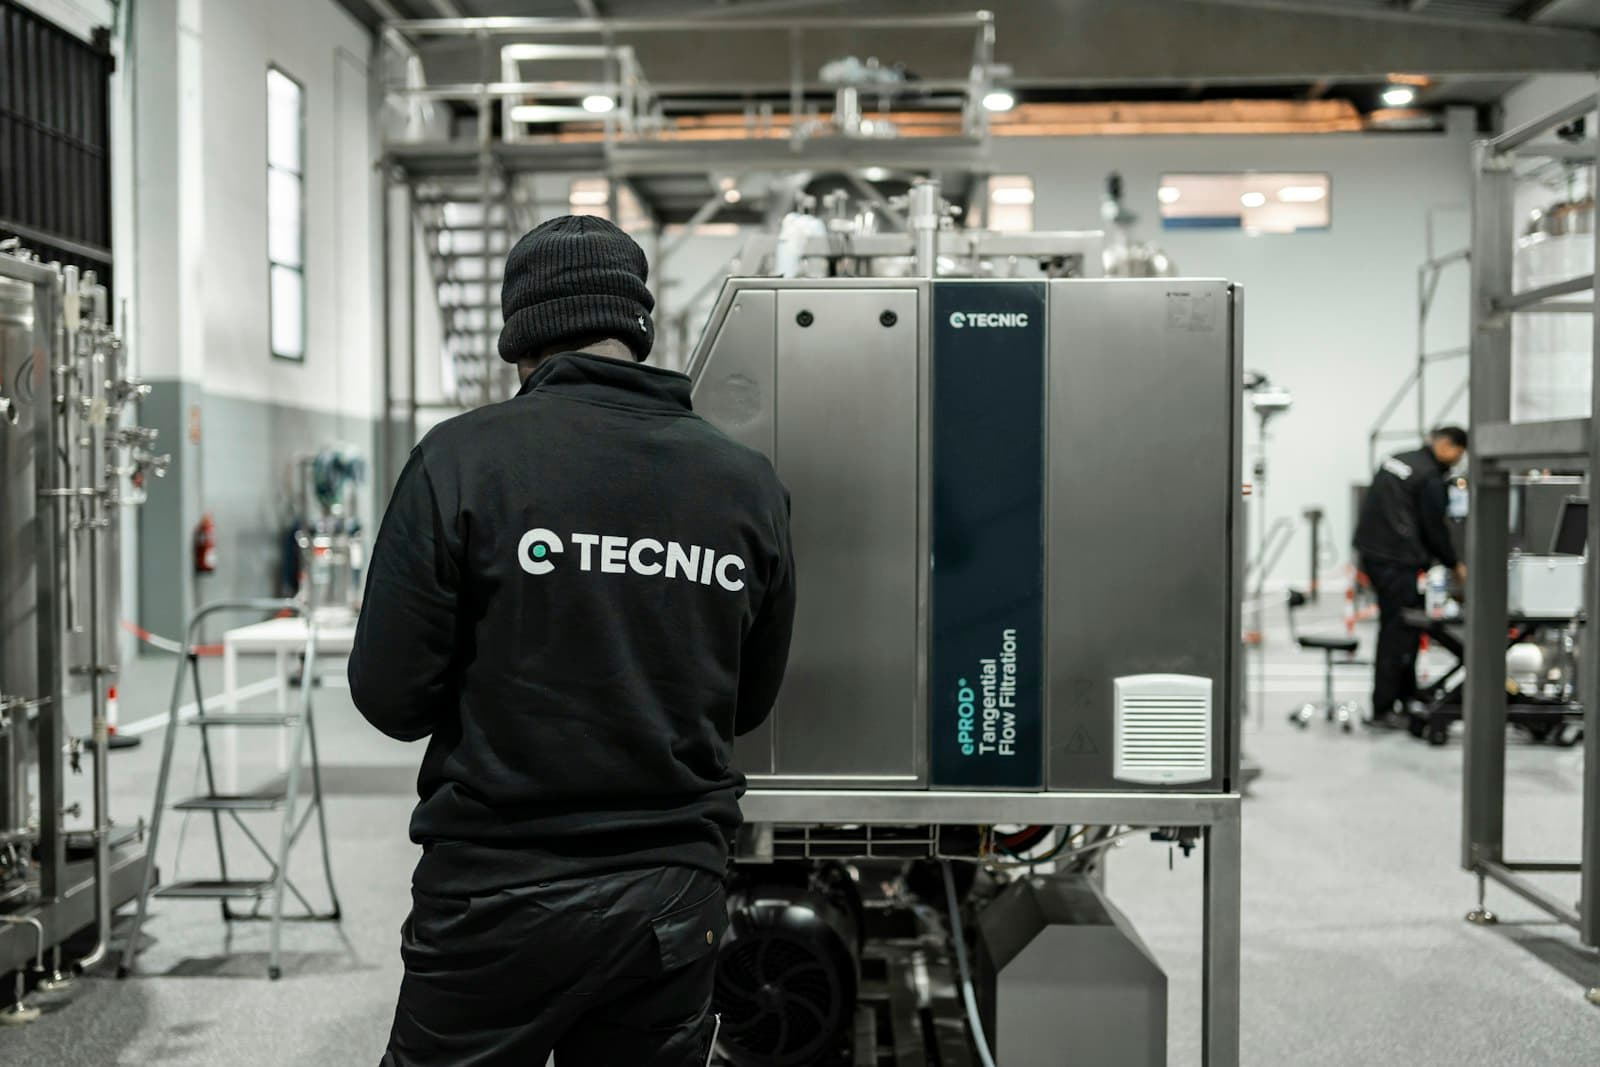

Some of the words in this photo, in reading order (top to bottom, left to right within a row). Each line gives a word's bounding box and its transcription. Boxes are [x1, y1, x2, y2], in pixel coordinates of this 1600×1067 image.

[967, 313, 1029, 327] TECNIC
[571, 532, 746, 592] TECNIC
[999, 628, 1017, 708] Filtration
[979, 659, 1000, 755] Tangential
[998, 711, 1016, 755] Flow
